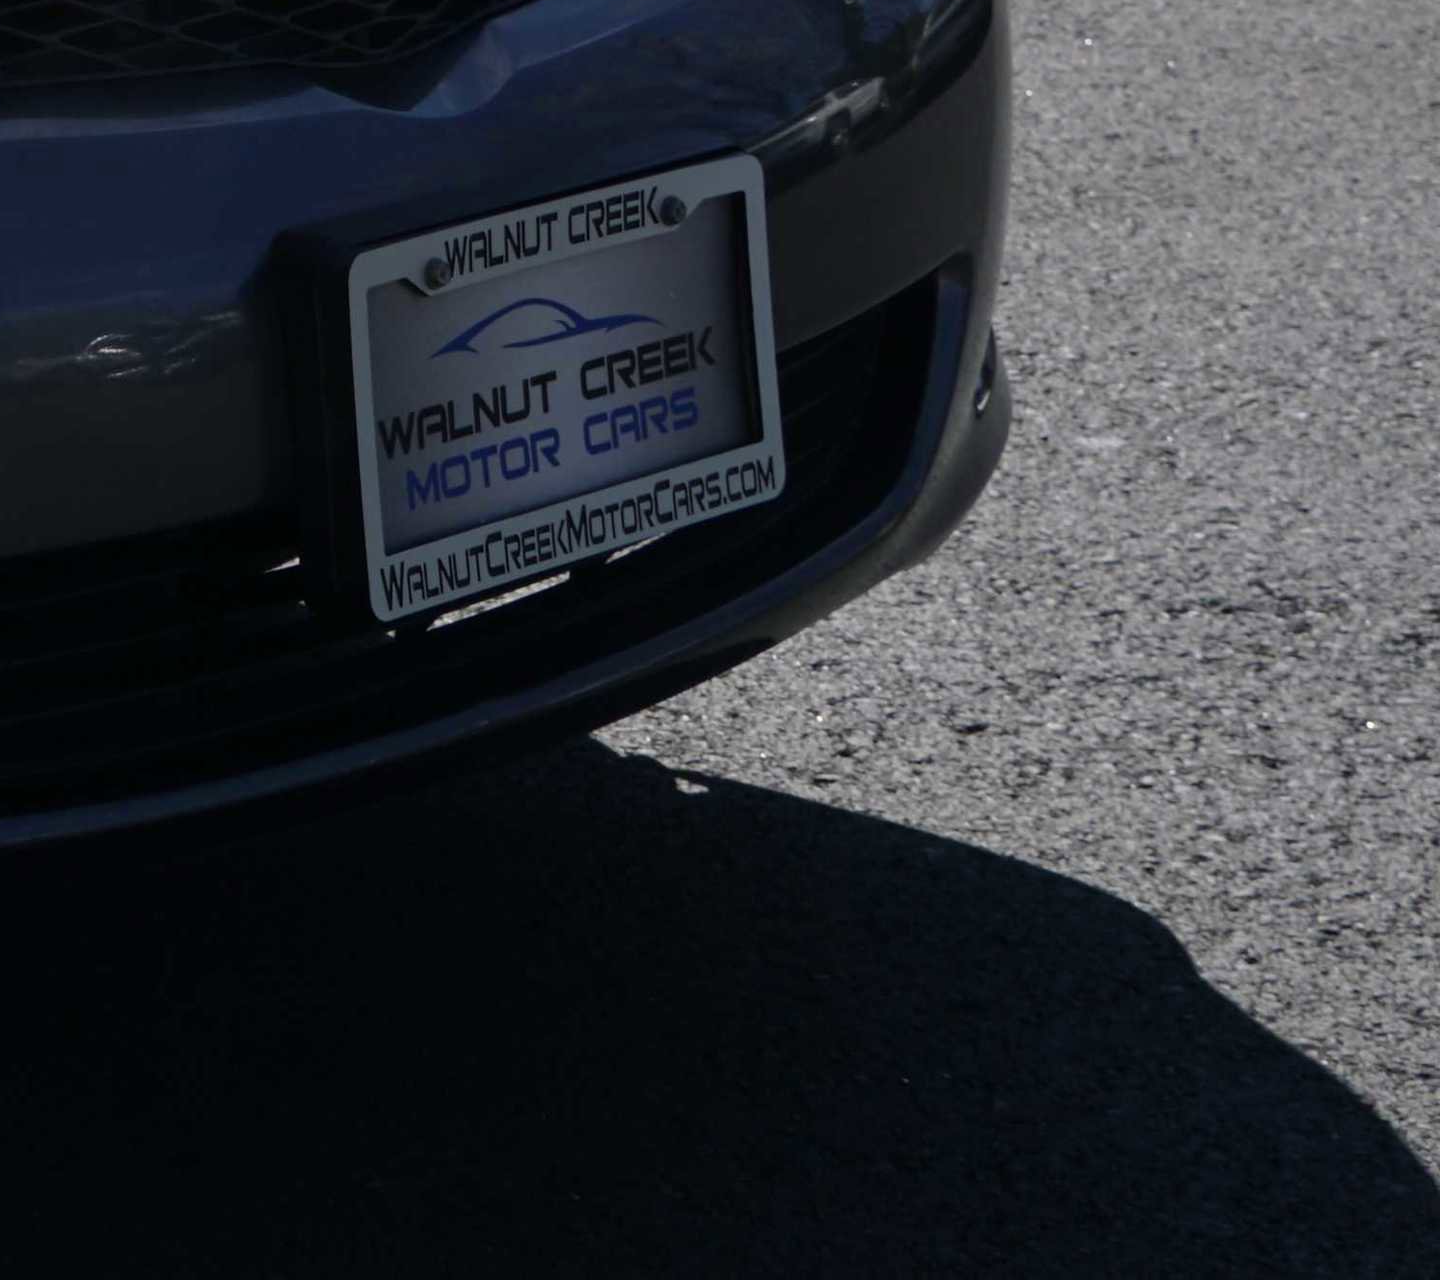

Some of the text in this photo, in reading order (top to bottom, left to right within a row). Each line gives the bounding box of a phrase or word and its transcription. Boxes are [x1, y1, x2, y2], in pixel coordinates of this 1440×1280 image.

[444, 186, 659, 278] WALNUT CREEK
[379, 326, 716, 460] WALNUT CREEK
[406, 386, 700, 512] MOTOR CARS
